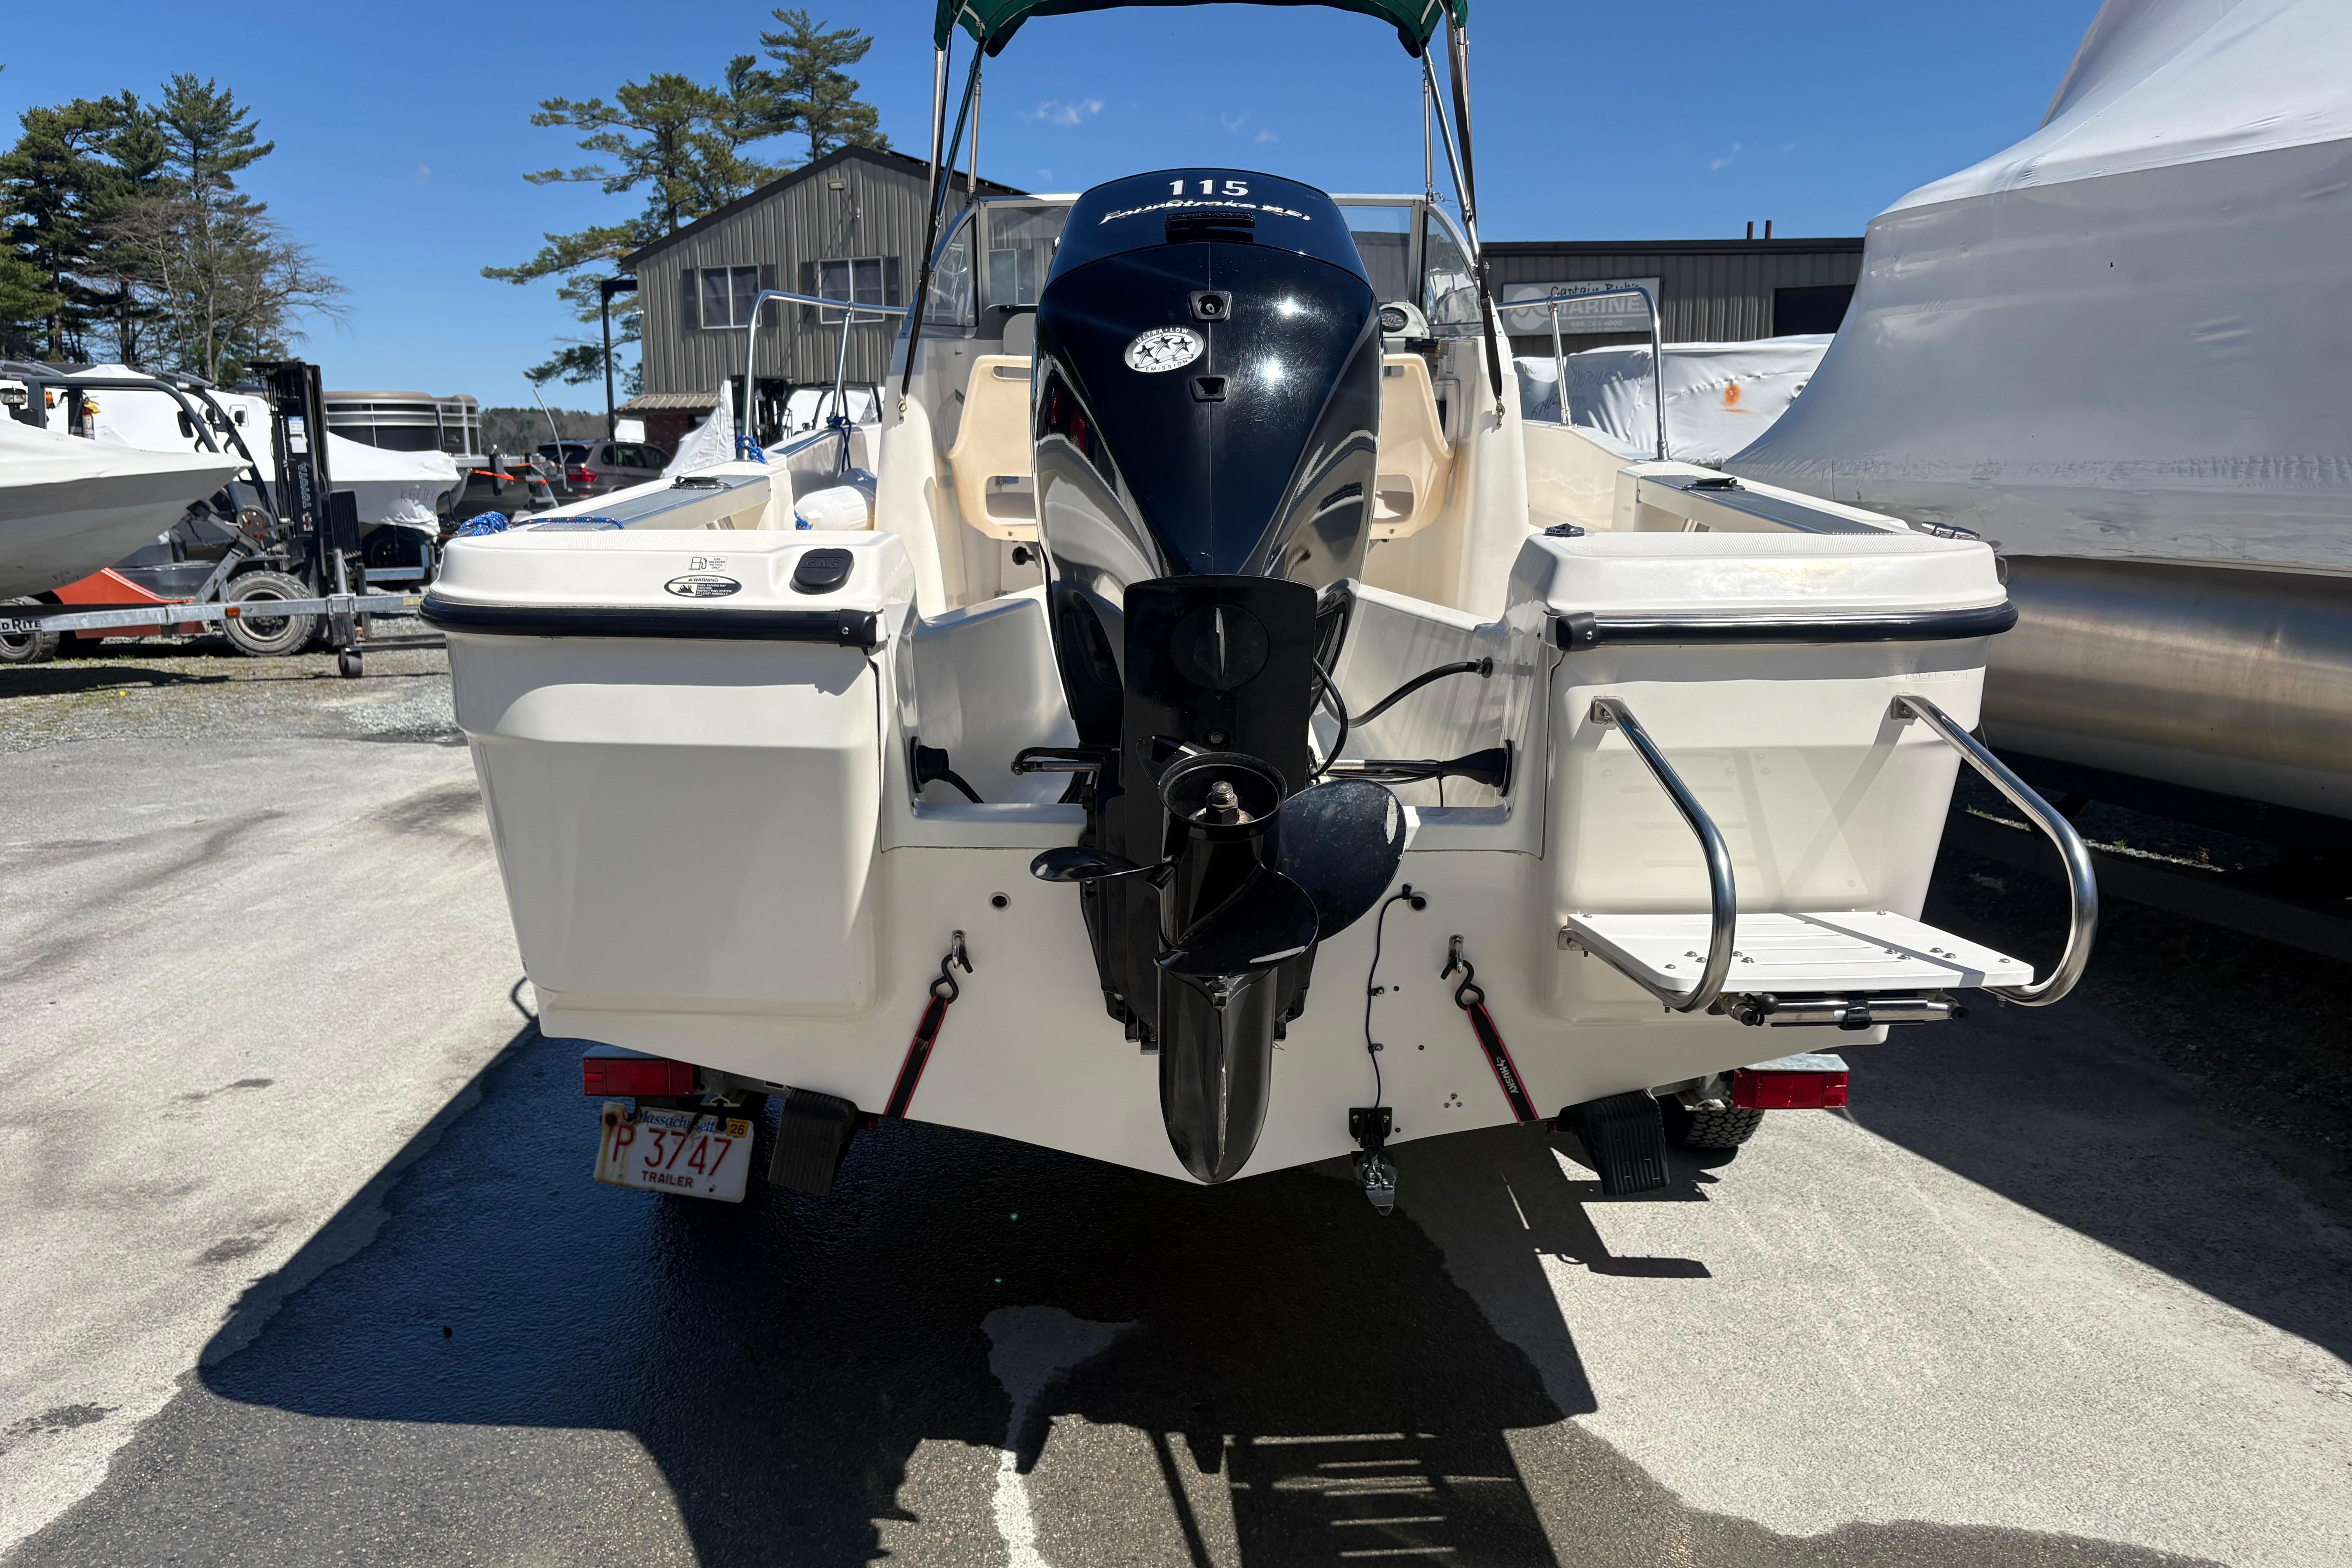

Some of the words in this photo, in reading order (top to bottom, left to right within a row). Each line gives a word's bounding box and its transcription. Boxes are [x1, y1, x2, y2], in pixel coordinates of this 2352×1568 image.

[1169, 180, 1249, 196] 115
[1136, 329, 1164, 343] ULTRA
[1146, 359, 1188, 371] EMISSION
[298, 462, 312, 509] TOYOTA
[806, 558, 840, 567] GAS
[12, 618, 42, 632] RITE
[1499, 1066, 1519, 1093] HUSKY
[730, 1124, 745, 1135] 26
[612, 1124, 637, 1162] P
[644, 1127, 732, 1177] 3747
[642, 1171, 693, 1188] TRAILER
